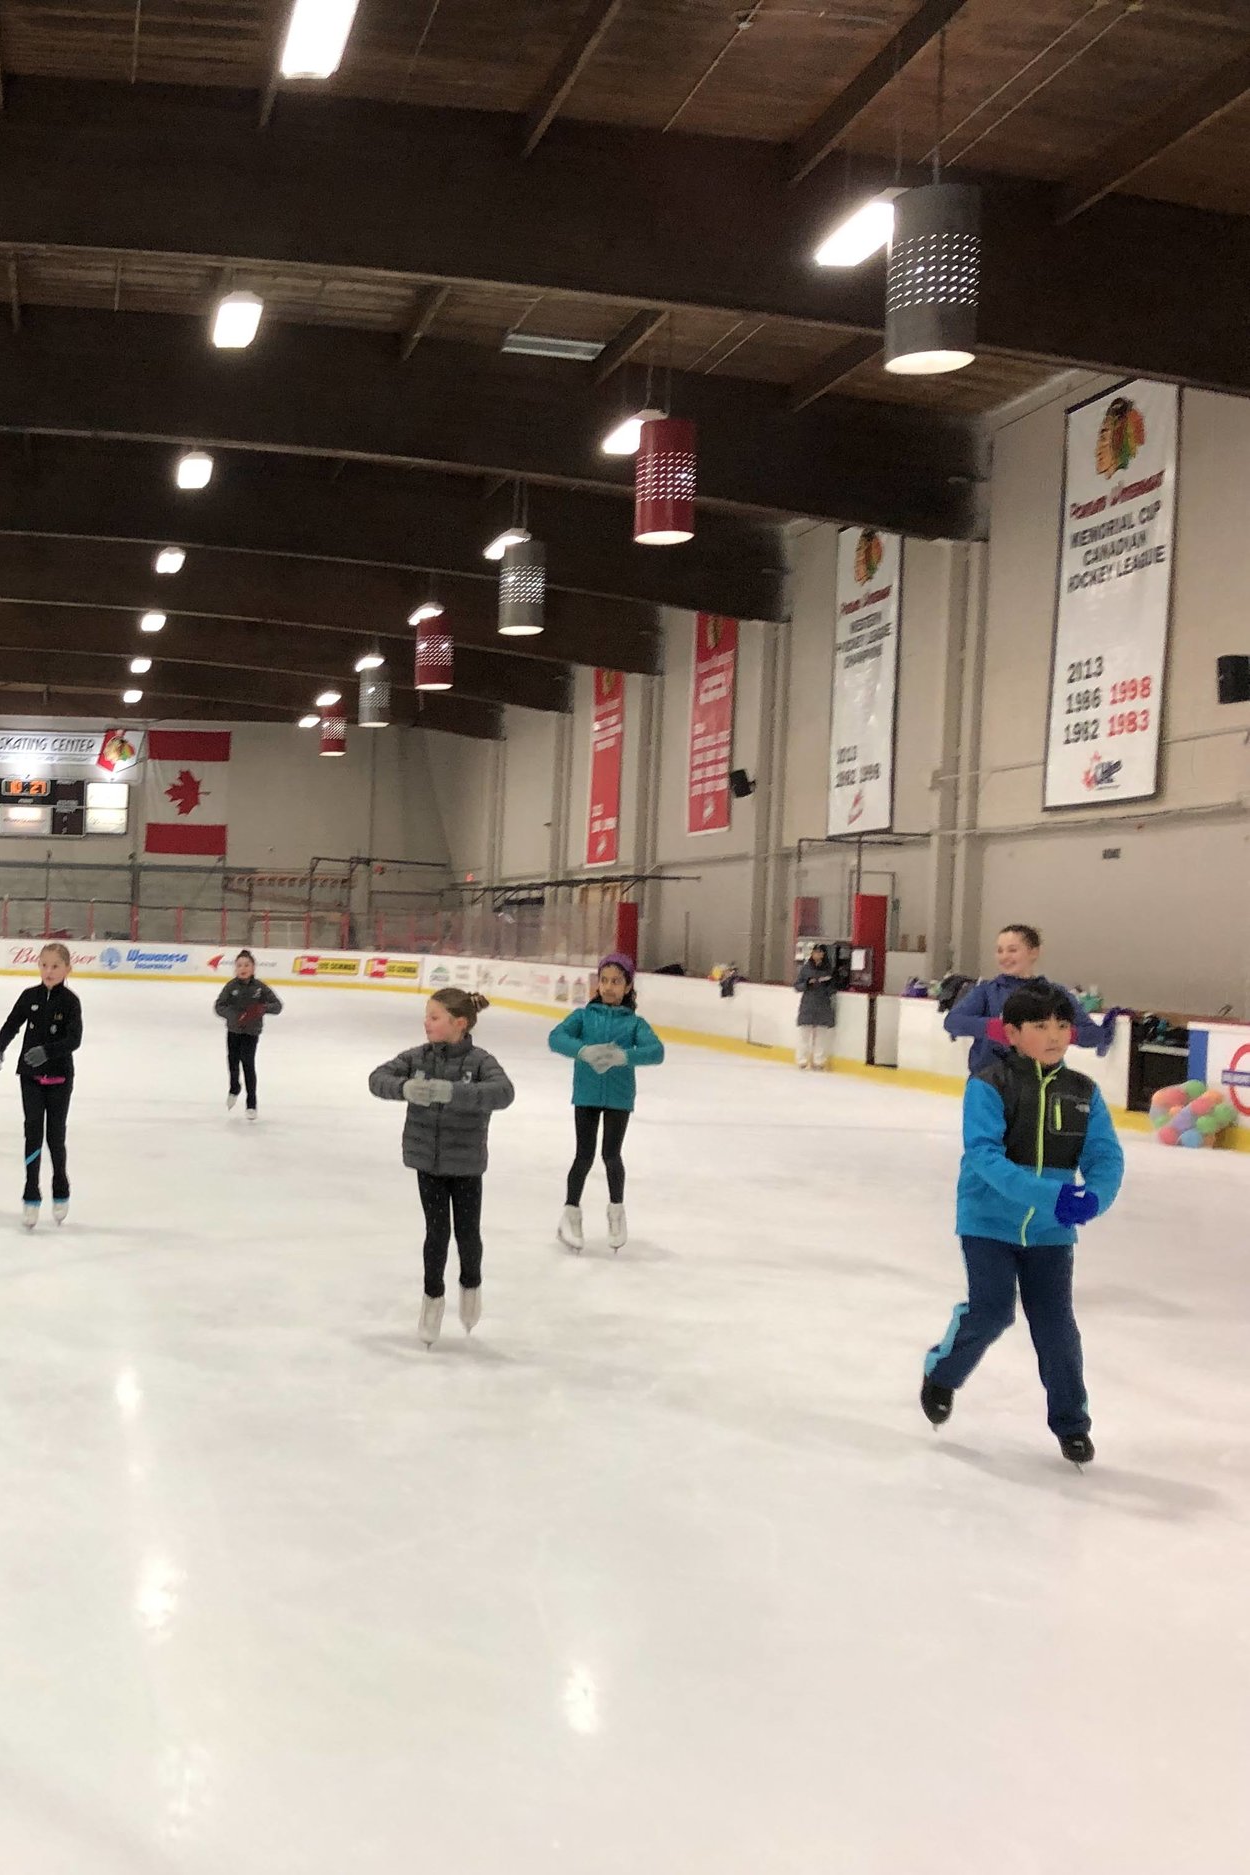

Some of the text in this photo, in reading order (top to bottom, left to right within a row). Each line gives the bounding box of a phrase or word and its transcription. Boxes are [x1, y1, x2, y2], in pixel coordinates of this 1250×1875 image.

[1139, 500, 1161, 524] CUP
[1116, 545, 1166, 577] LEAGUE
[1067, 655, 1103, 684] 2013
[1109, 675, 1152, 706] 1998
[0, 736, 47, 751] SKATING
[51, 738, 95, 752] CENTER
[11, 946, 96, 965] Buiser
[126, 948, 188, 963] Wawanesa
